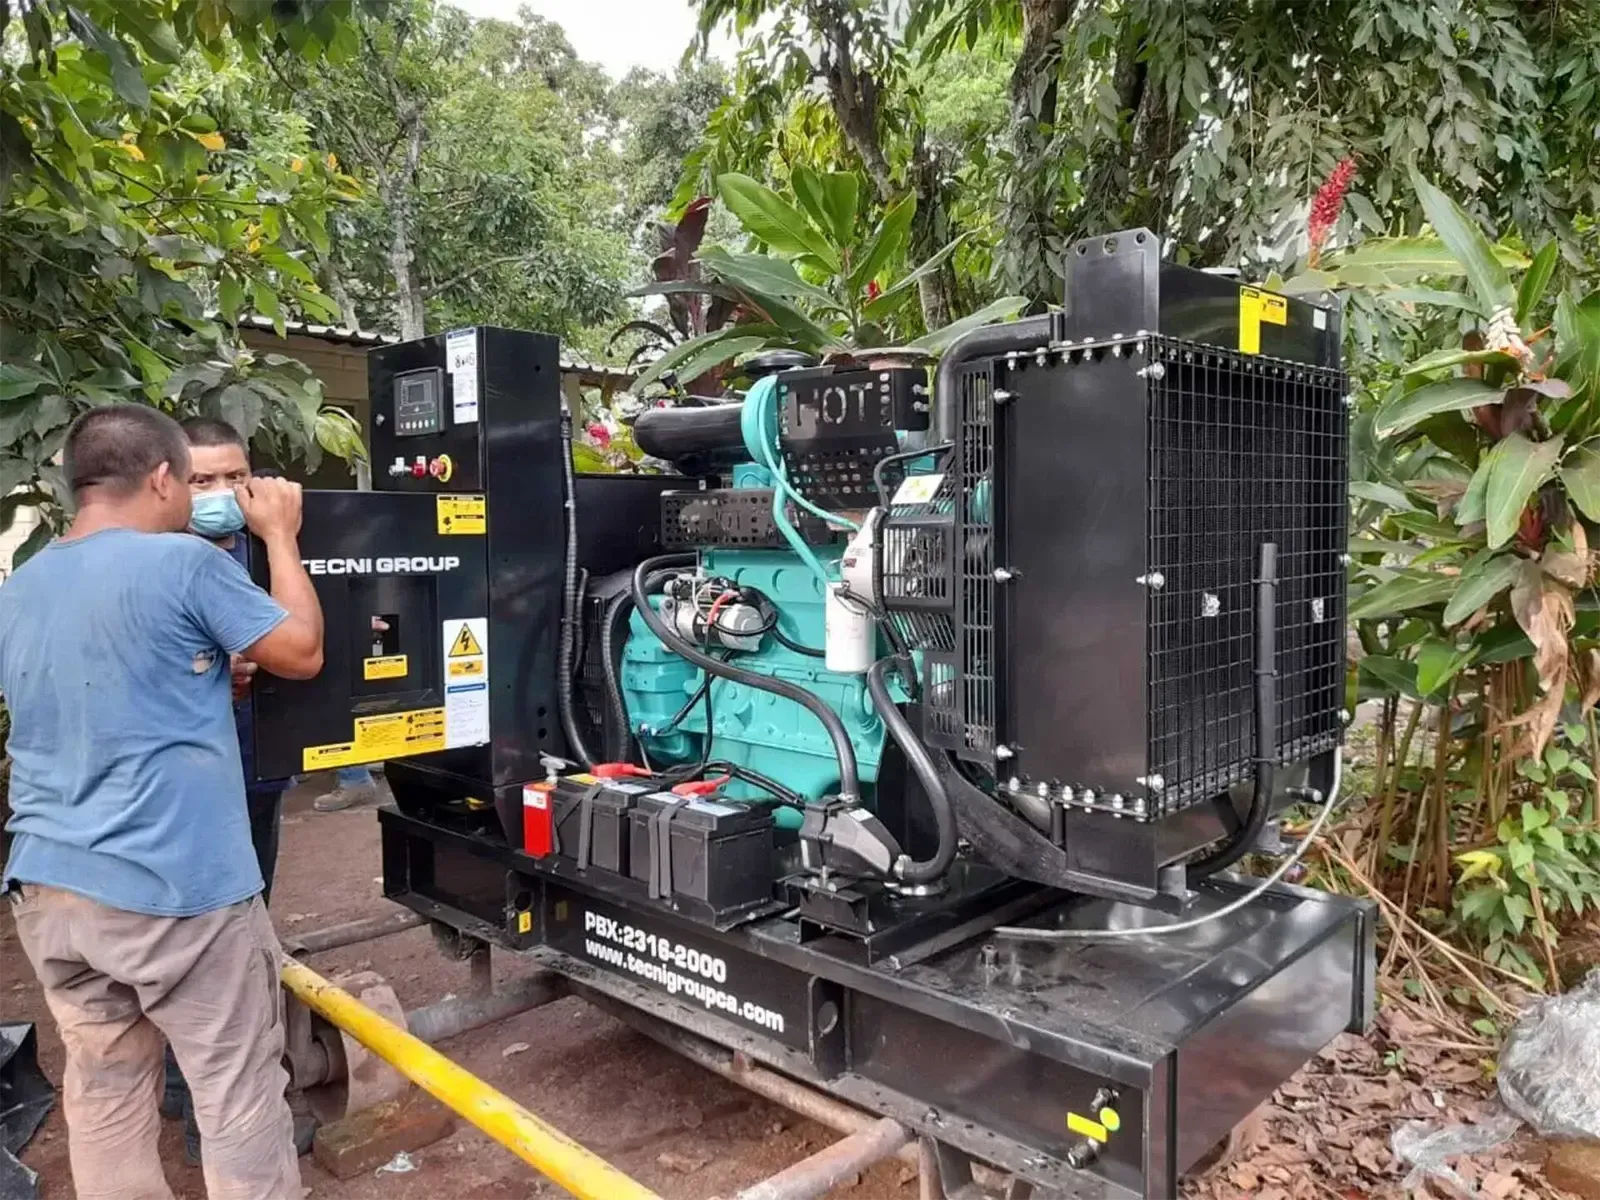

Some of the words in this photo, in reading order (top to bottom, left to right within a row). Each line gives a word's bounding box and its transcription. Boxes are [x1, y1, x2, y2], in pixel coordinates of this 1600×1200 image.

[796, 381, 873, 427] HOT
[375, 556, 460, 573] GROUP
[584, 910, 727, 984] PBX:2316-2000
[585, 938, 785, 1033] www.tecnigroupca.com
